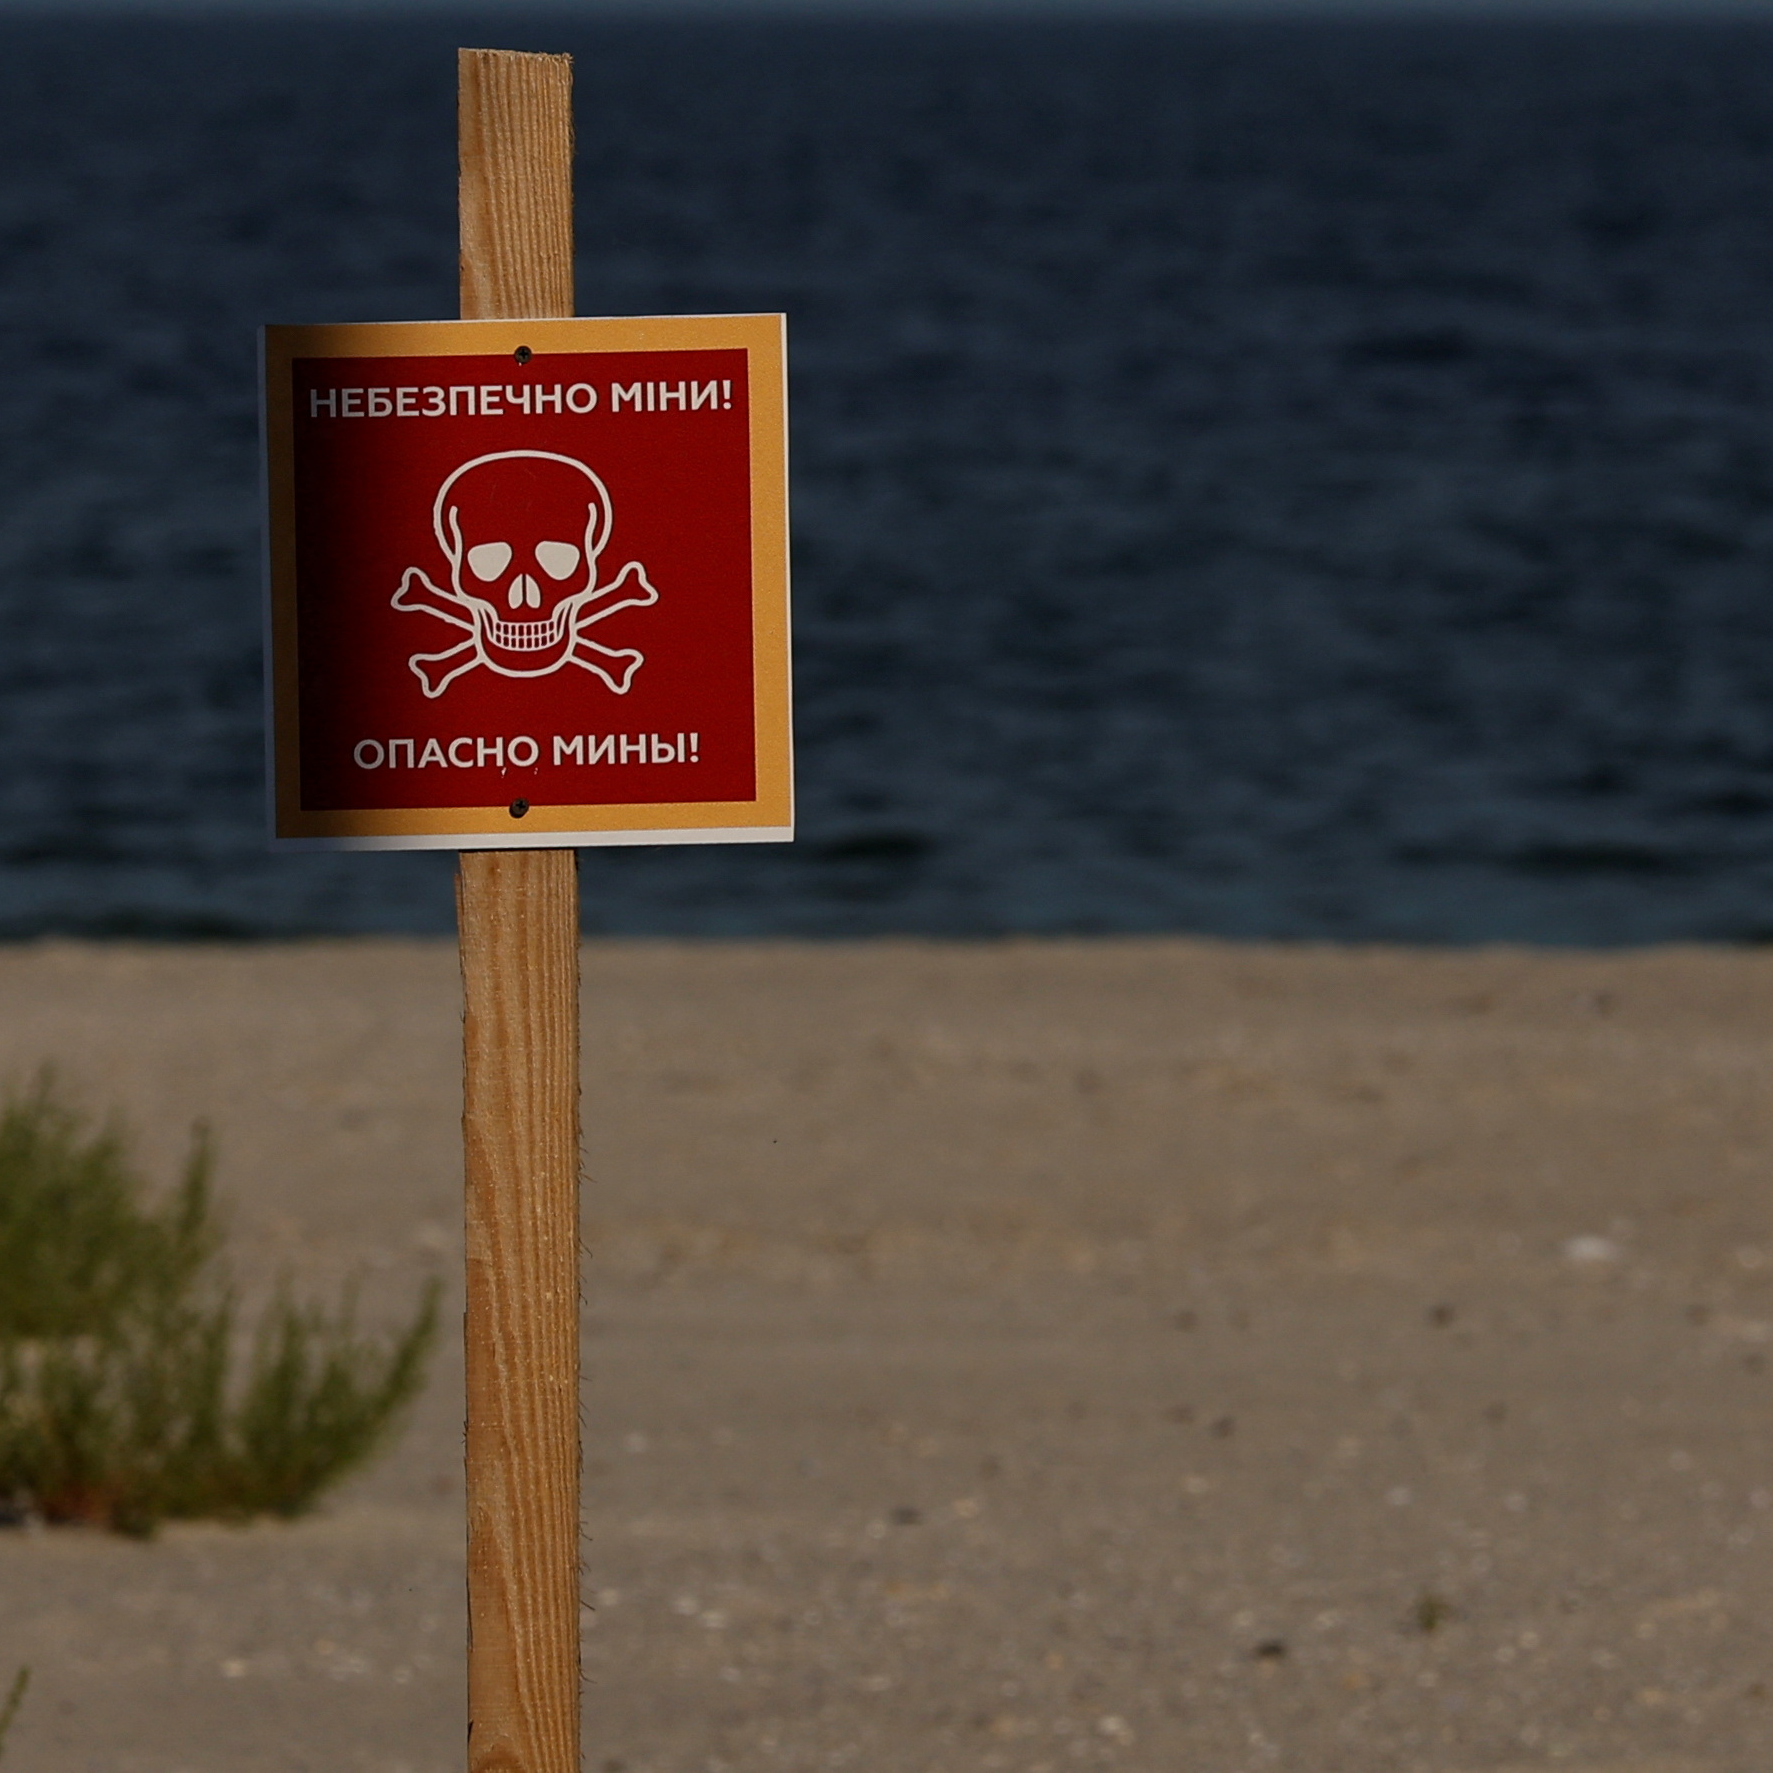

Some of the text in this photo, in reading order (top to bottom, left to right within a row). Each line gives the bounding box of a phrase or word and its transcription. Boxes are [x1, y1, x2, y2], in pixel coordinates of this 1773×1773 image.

[309, 379, 732, 418] НЕБЕЗПЕЧНО МІНИ!
[353, 732, 700, 770] ОПАСНО МИНЫ!
